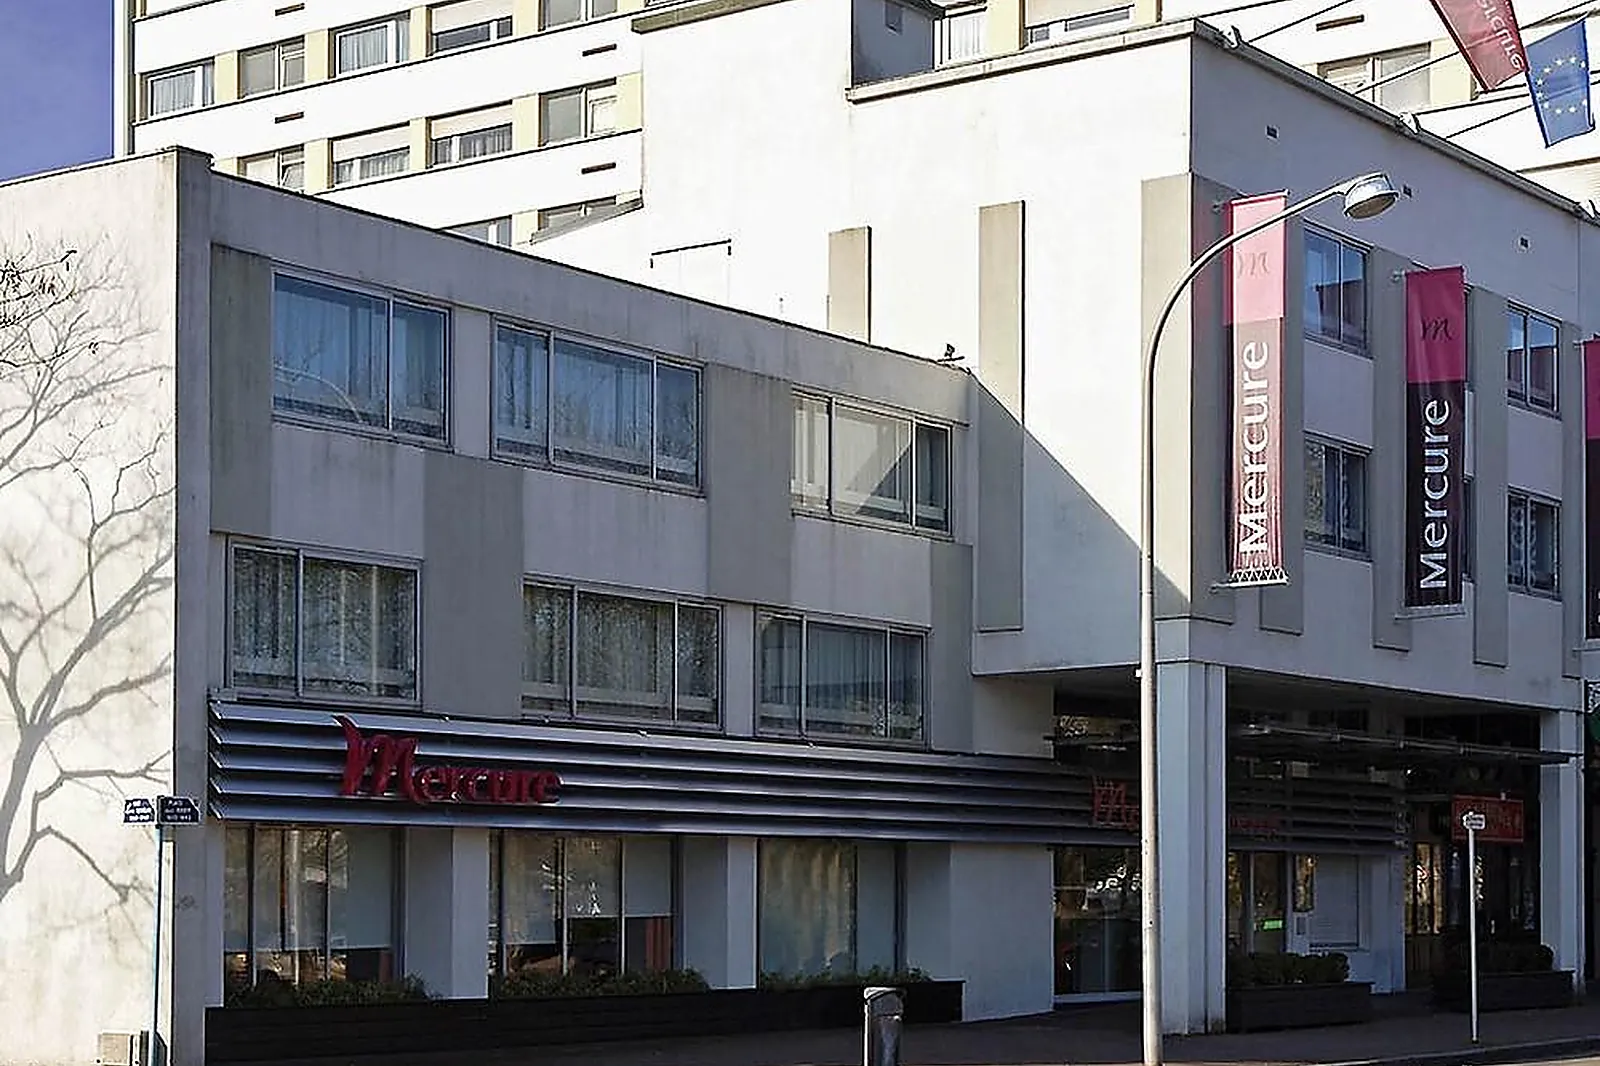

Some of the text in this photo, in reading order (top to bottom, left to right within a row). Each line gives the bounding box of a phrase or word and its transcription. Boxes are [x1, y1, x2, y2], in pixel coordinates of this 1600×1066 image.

[1238, 341, 1269, 554] Mercure
[1420, 399, 1449, 589] Mercure
[331, 713, 563, 805] Mercure
